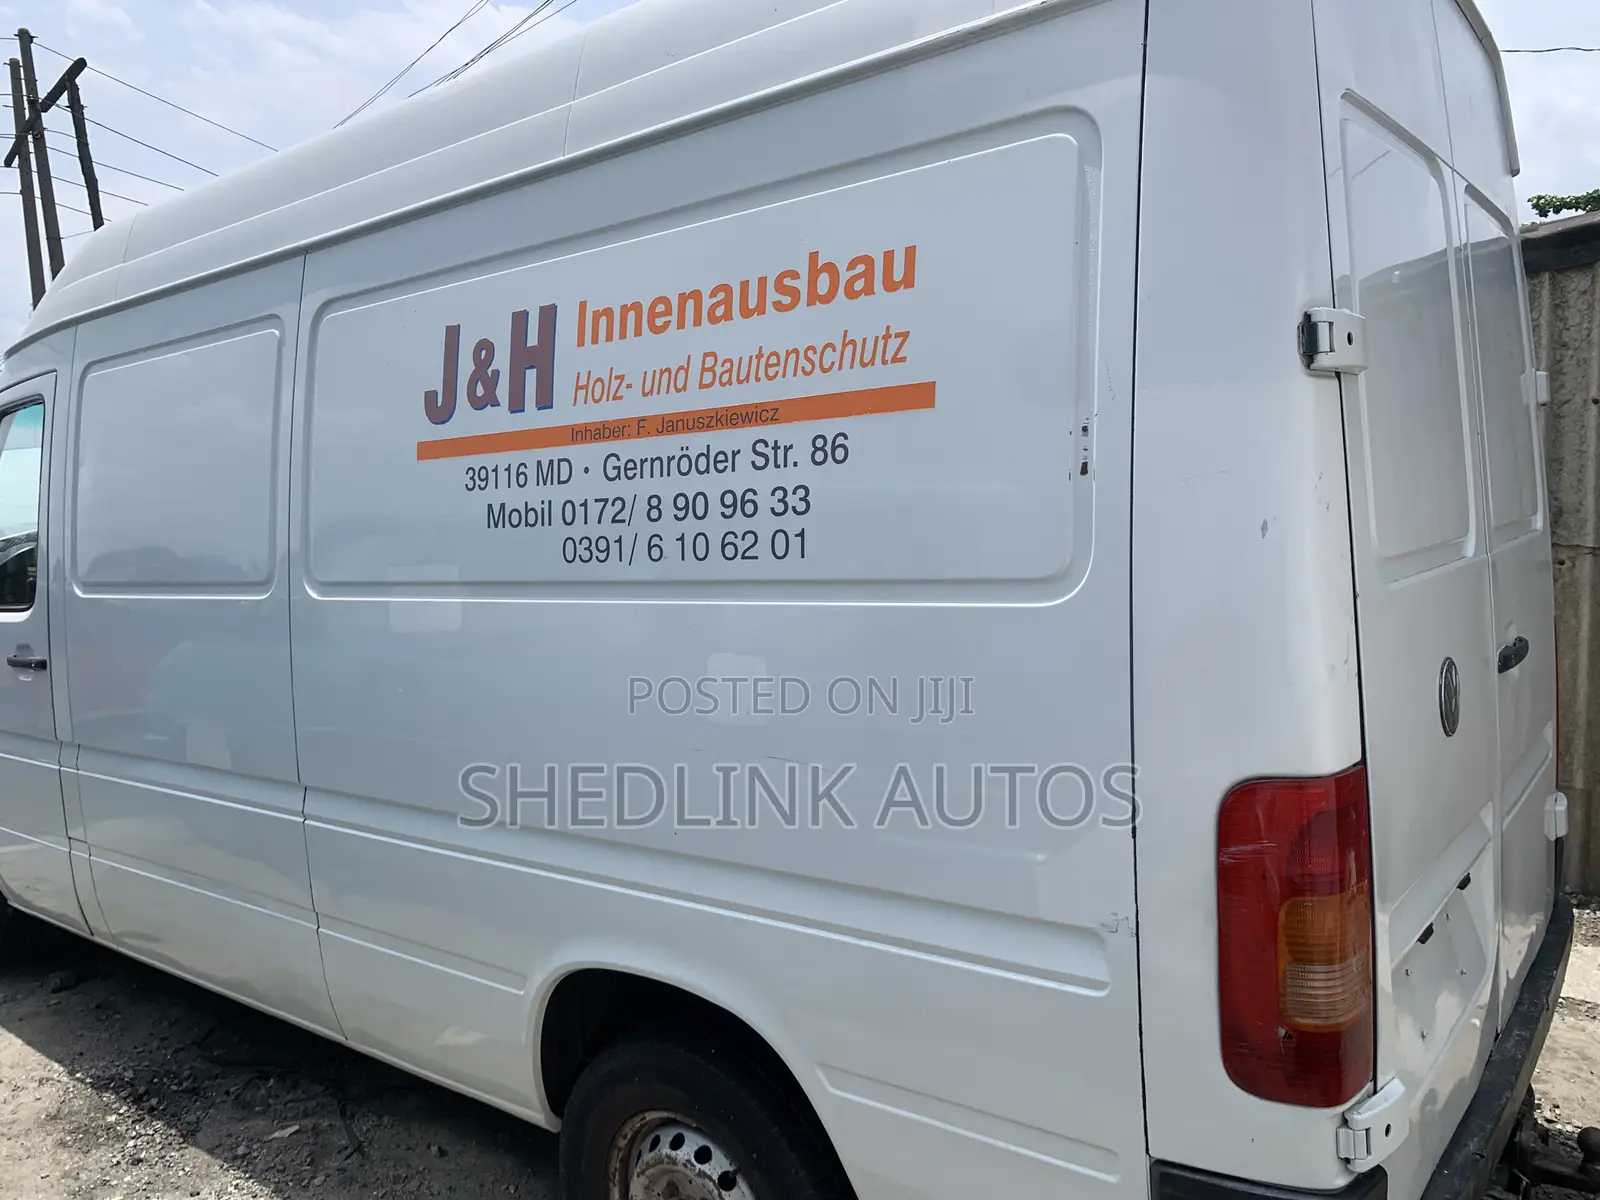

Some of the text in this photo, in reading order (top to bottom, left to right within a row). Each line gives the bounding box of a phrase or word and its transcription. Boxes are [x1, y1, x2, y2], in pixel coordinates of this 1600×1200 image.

[576, 245, 916, 347] Innenausbau
[424, 304, 557, 425] J&H
[573, 325, 911, 407] Holz- und Bautenschutz
[571, 406, 779, 443] Inhaber: F. Januszkiewicz
[465, 463, 528, 492] 39116
[536, 458, 573, 487] MD
[603, 445, 740, 482] Gernröder
[750, 439, 799, 471] Str.
[810, 433, 849, 465] 86
[487, 485, 811, 529] Mobil 0172/ 8 90 96 33
[562, 528, 807, 566] 0391/ 6 10 62 01
